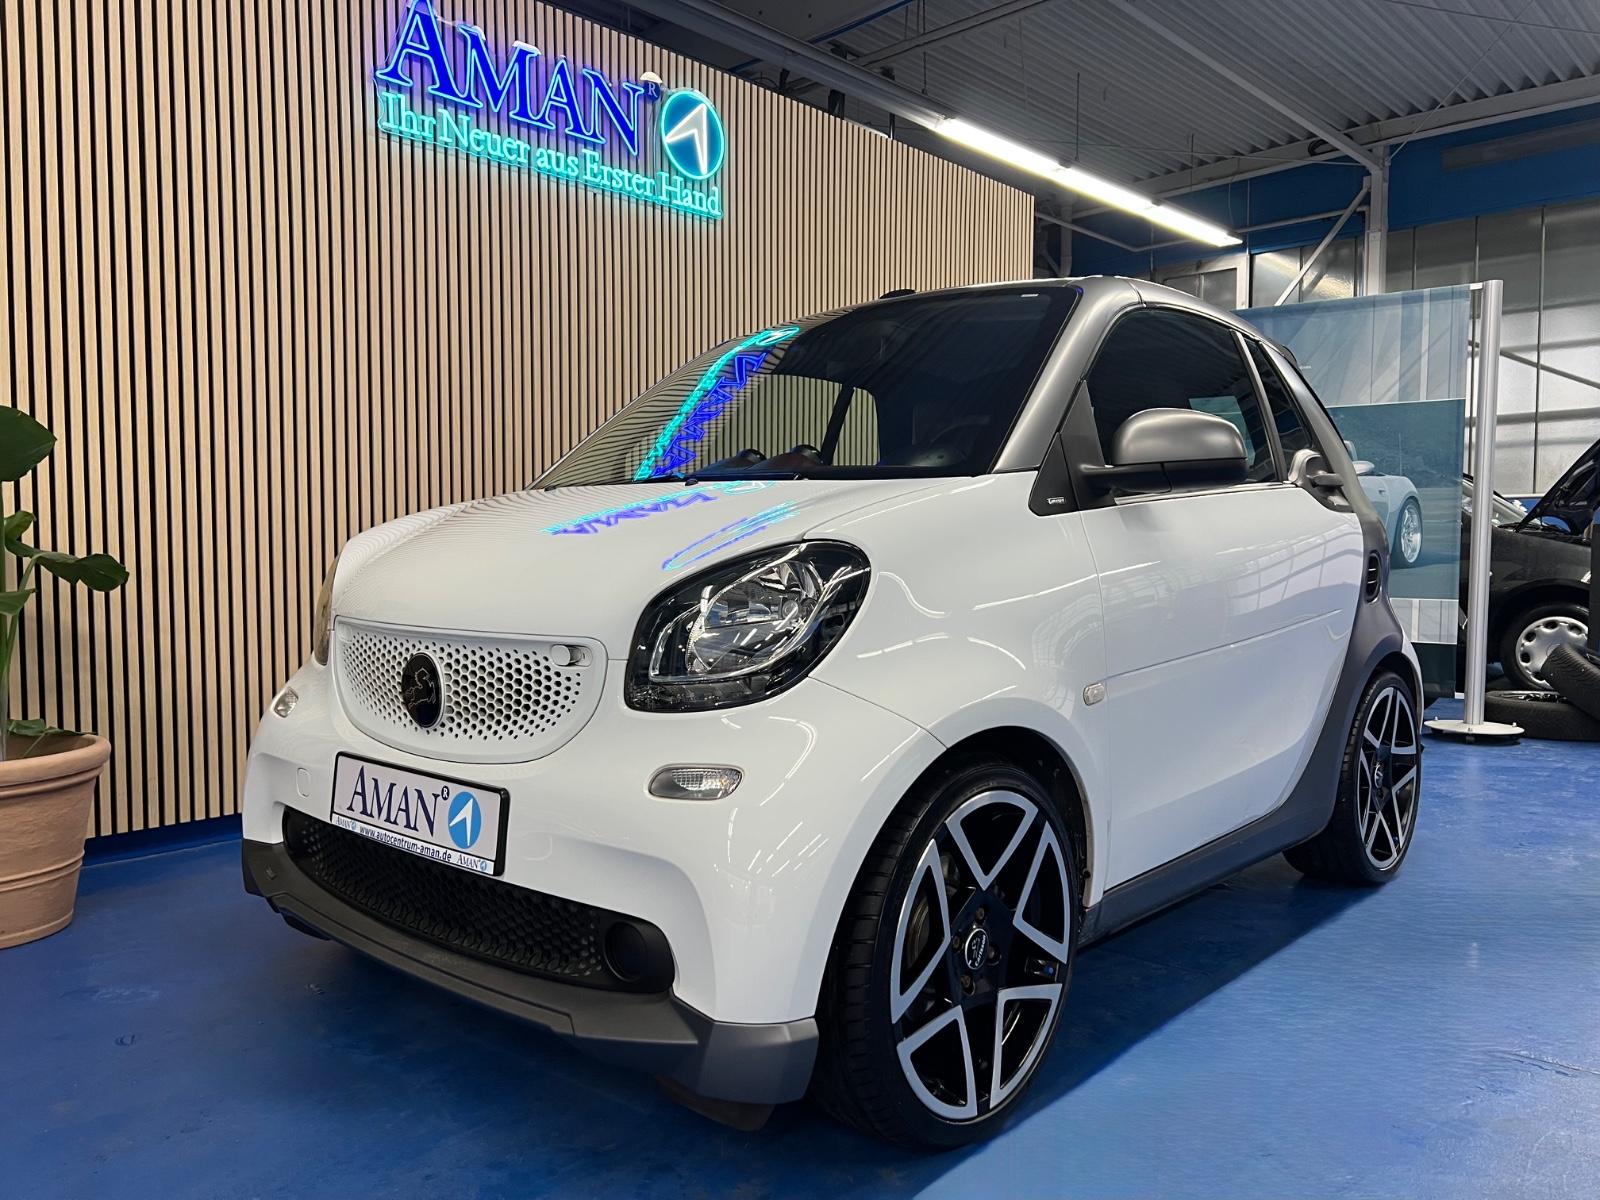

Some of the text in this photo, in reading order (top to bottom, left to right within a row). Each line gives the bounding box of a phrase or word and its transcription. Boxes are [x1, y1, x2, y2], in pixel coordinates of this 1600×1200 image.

[375, 0, 644, 156] AMAN
[381, 91, 722, 216] Ihr Neuer aus Erster Hand
[346, 765, 440, 837] AMAN
[359, 826, 452, 861] www.autocentrum-aman.de
